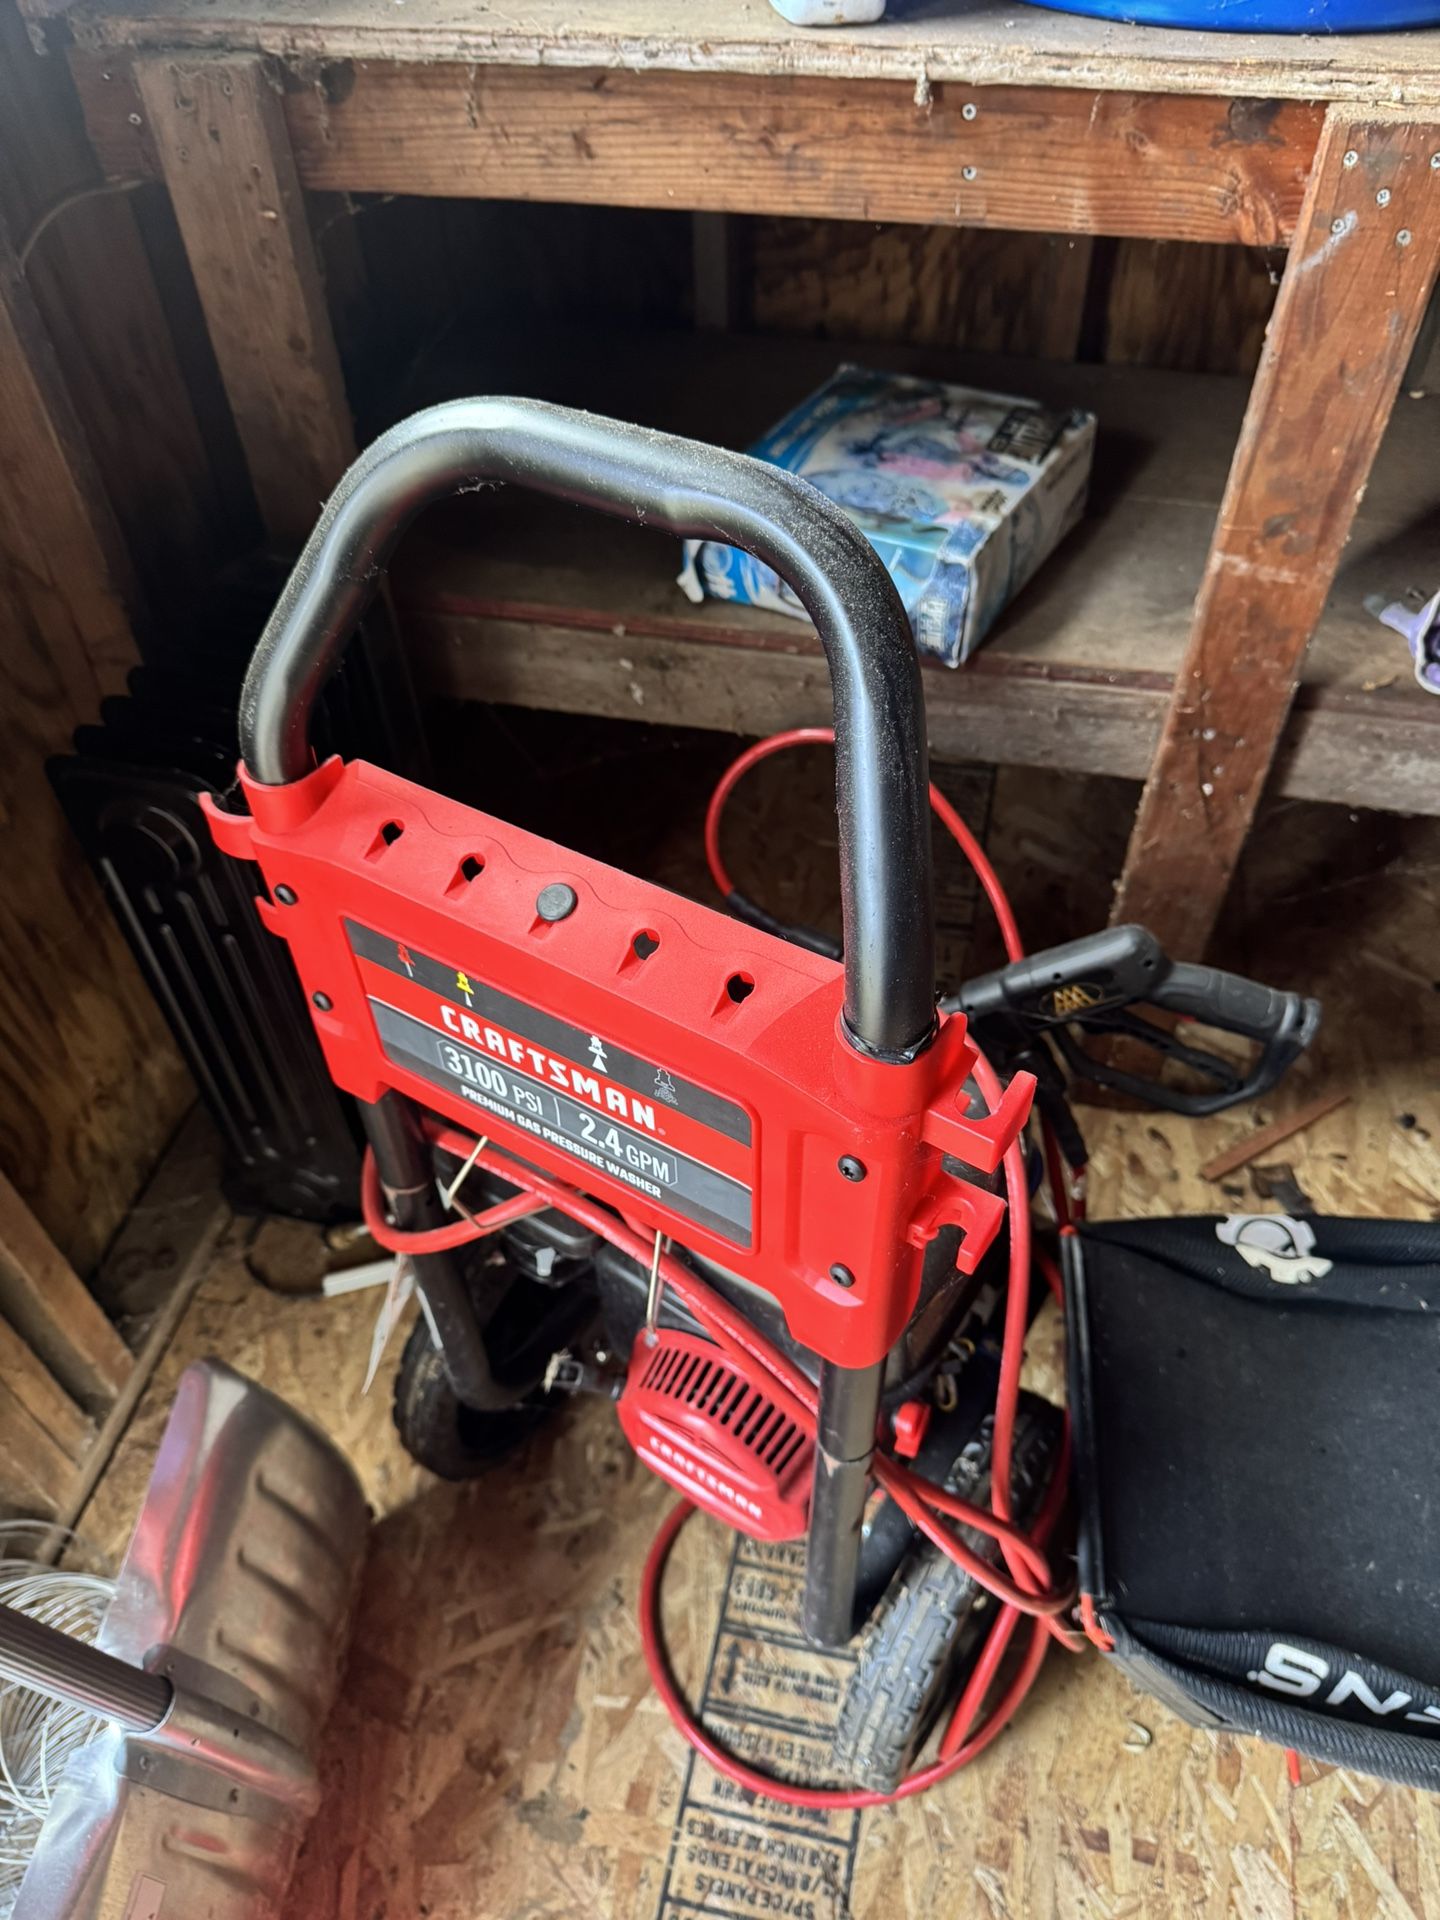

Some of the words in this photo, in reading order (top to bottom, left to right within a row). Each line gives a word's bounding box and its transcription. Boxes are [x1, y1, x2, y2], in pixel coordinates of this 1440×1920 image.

[440, 1004, 658, 1133] CRAFTSMAN
[443, 1045, 507, 1098] 3100
[512, 1083, 545, 1117] PSI
[579, 1113, 624, 1158] 2.4
[626, 1144, 670, 1184] GPM
[461, 1085, 516, 1120] PREMIUM
[516, 1113, 543, 1136] GAS
[542, 1126, 604, 1168] PRESSURE
[604, 1159, 663, 1199] WASHER
[649, 1436, 763, 1520] CRAFTSMAN
[1256, 1642, 1440, 1725] SN
[686, 1843, 730, 1871] ENDS
[733, 1856, 754, 1875] AT
